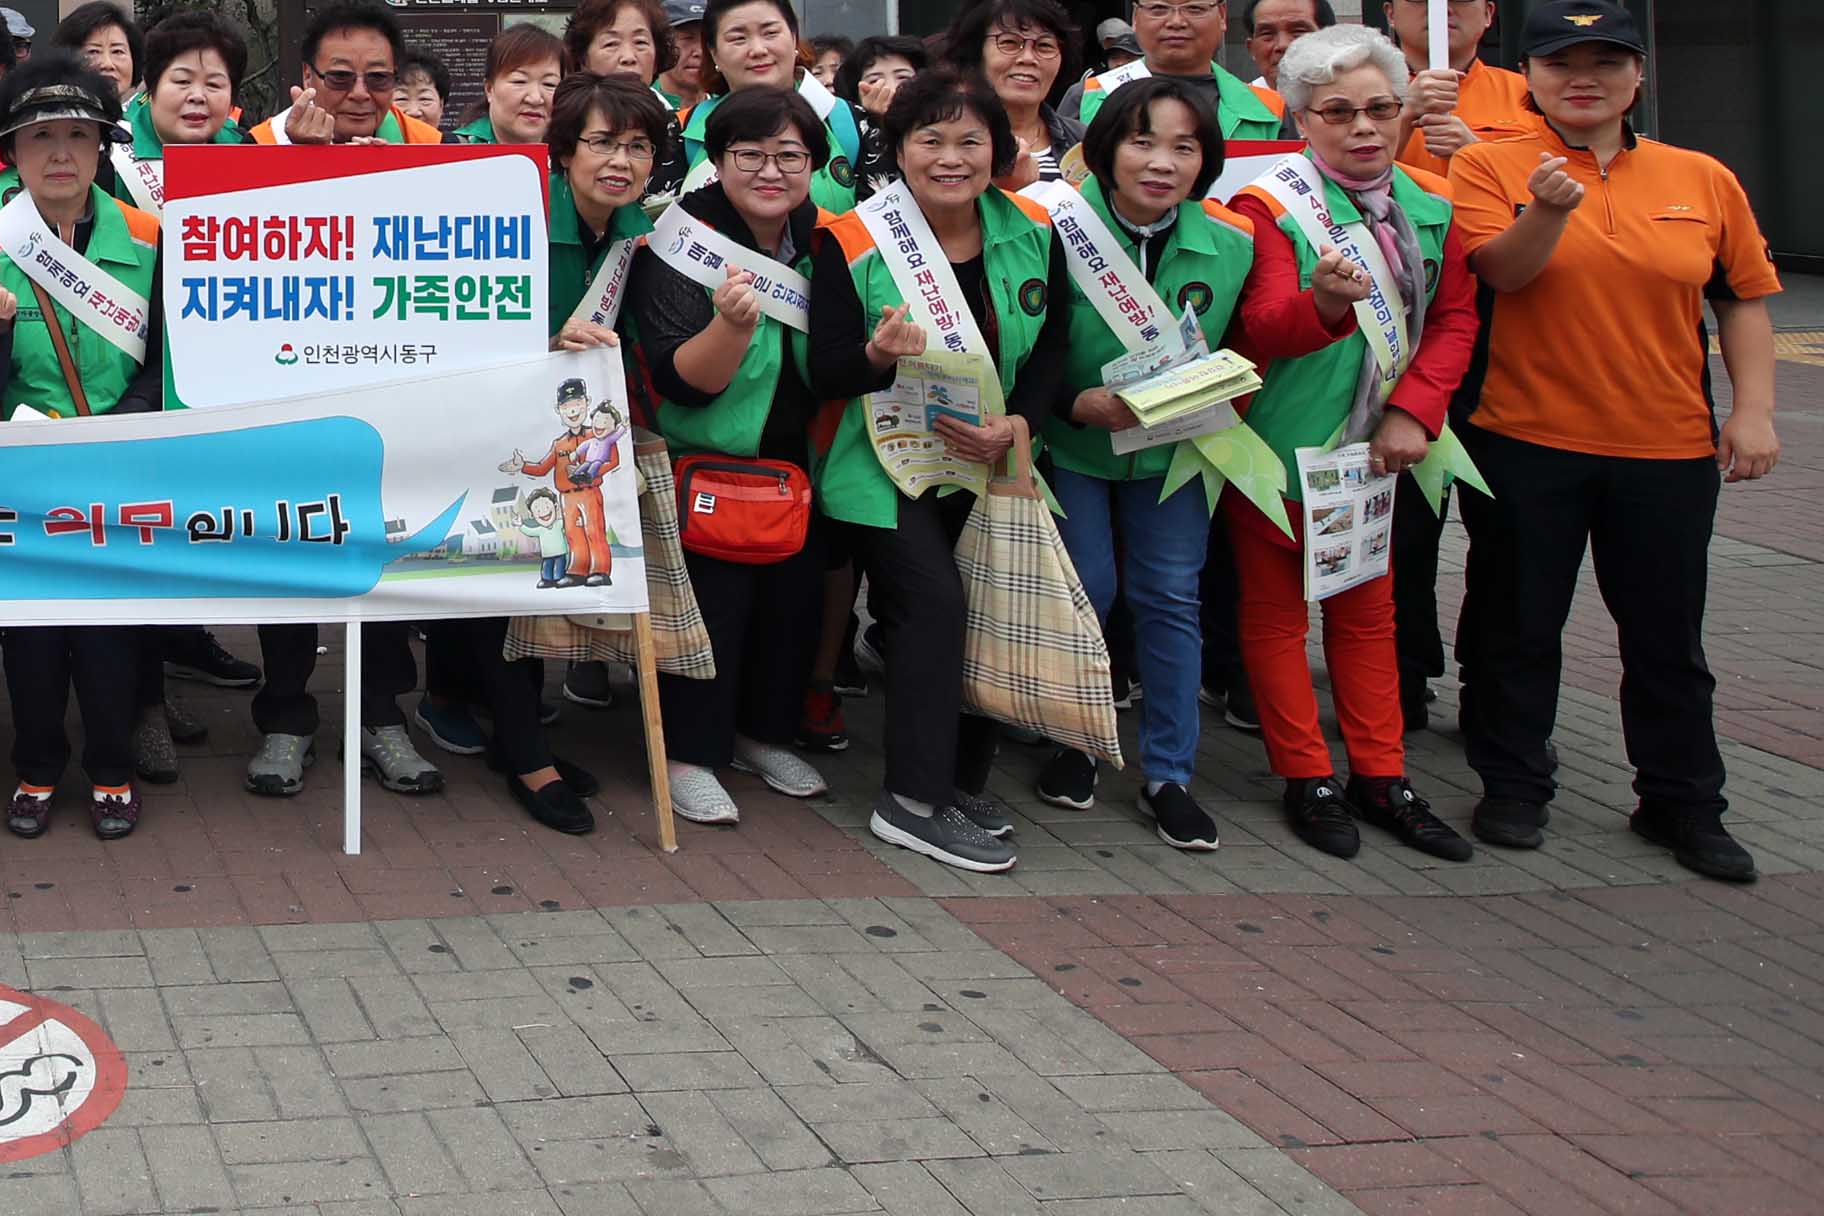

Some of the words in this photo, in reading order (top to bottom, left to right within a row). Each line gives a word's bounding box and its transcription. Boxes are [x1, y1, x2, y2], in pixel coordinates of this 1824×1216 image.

[1275, 166, 1312, 196] 매월
[182, 215, 355, 262] 참여하자!
[373, 215, 531, 261] 재난대비
[688, 242, 723, 269] 매월
[36, 250, 90, 298] 함께해요
[88, 290, 144, 332] 재난예방!
[883, 210, 926, 269] 함께해요
[915, 269, 960, 330] 재난예방!
[1058, 217, 1108, 273] 함께해요
[1099, 271, 1154, 326] 재난예방!
[182, 275, 355, 321] 지켜내자!
[373, 275, 531, 321] 가족안전
[303, 343, 438, 365] 인천광역시동구
